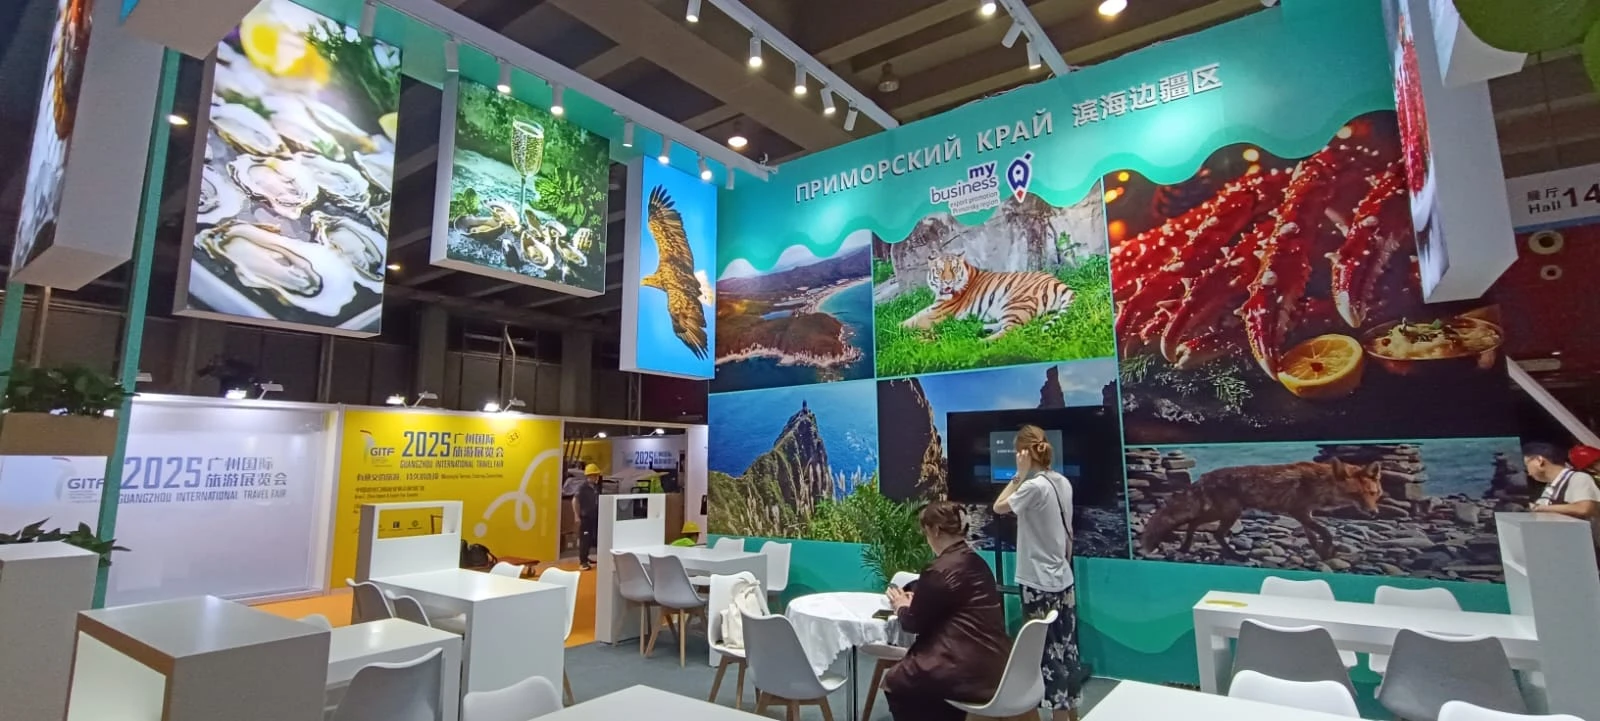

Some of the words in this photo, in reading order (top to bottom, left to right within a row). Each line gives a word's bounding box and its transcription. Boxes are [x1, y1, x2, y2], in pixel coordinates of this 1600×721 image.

[795, 134, 963, 203] ПРИМОРСКИЙ
[976, 109, 1054, 151] КРАЙ
[1071, 63, 1223, 127] 滨海边疆区
[969, 163, 995, 178] my
[932, 177, 997, 202] business
[1562, 183, 1600, 208] 14
[950, 198, 968, 208] export
[969, 192, 997, 203] promotion
[980, 199, 999, 210] region
[1528, 200, 1561, 214] Hall
[370, 447, 394, 457] GITF
[402, 431, 450, 457] 2025
[207, 456, 273, 472] 广州国际
[400, 459, 433, 469] GUANGZHOU
[435, 459, 473, 469] INTERNATIONAL
[635, 451, 654, 464] 2025
[120, 457, 202, 490] 2025
[204, 472, 288, 488] 旅游展览会
[118, 492, 172, 504] GUANGZHOU
[176, 490, 238, 502] INTERNATIONAL
[243, 489, 269, 500] TRAVEL
[271, 488, 287, 499] FAIR
